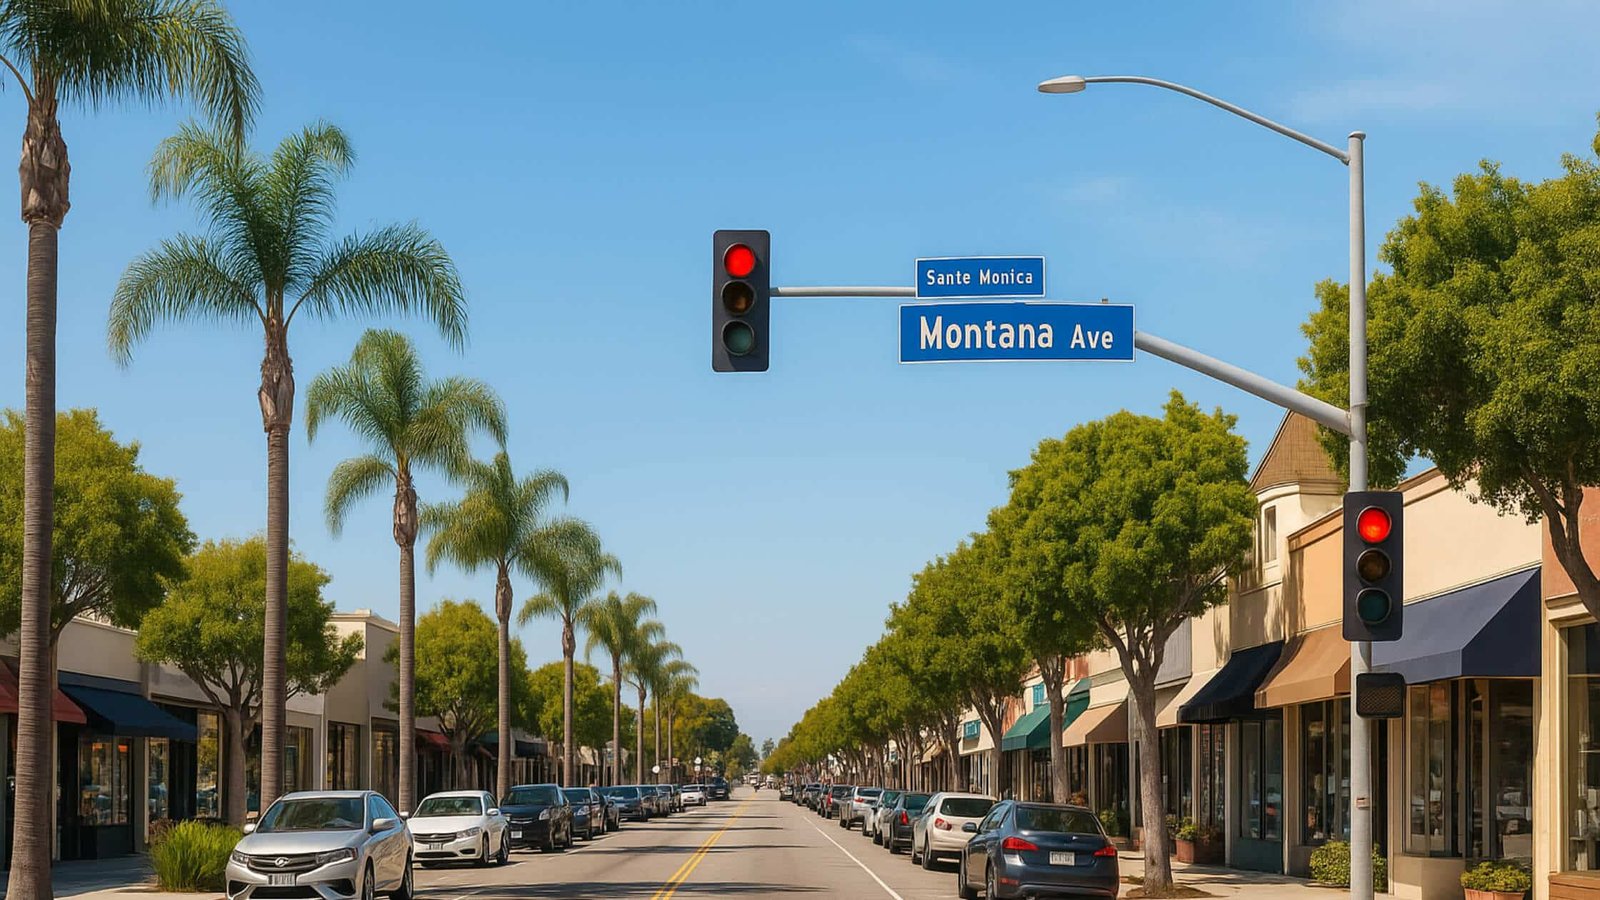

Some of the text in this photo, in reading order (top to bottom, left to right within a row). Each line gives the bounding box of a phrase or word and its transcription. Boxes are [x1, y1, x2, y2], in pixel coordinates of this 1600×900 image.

[926, 268, 1033, 286] Sante Monica
[919, 316, 1114, 350] Montana Ave
